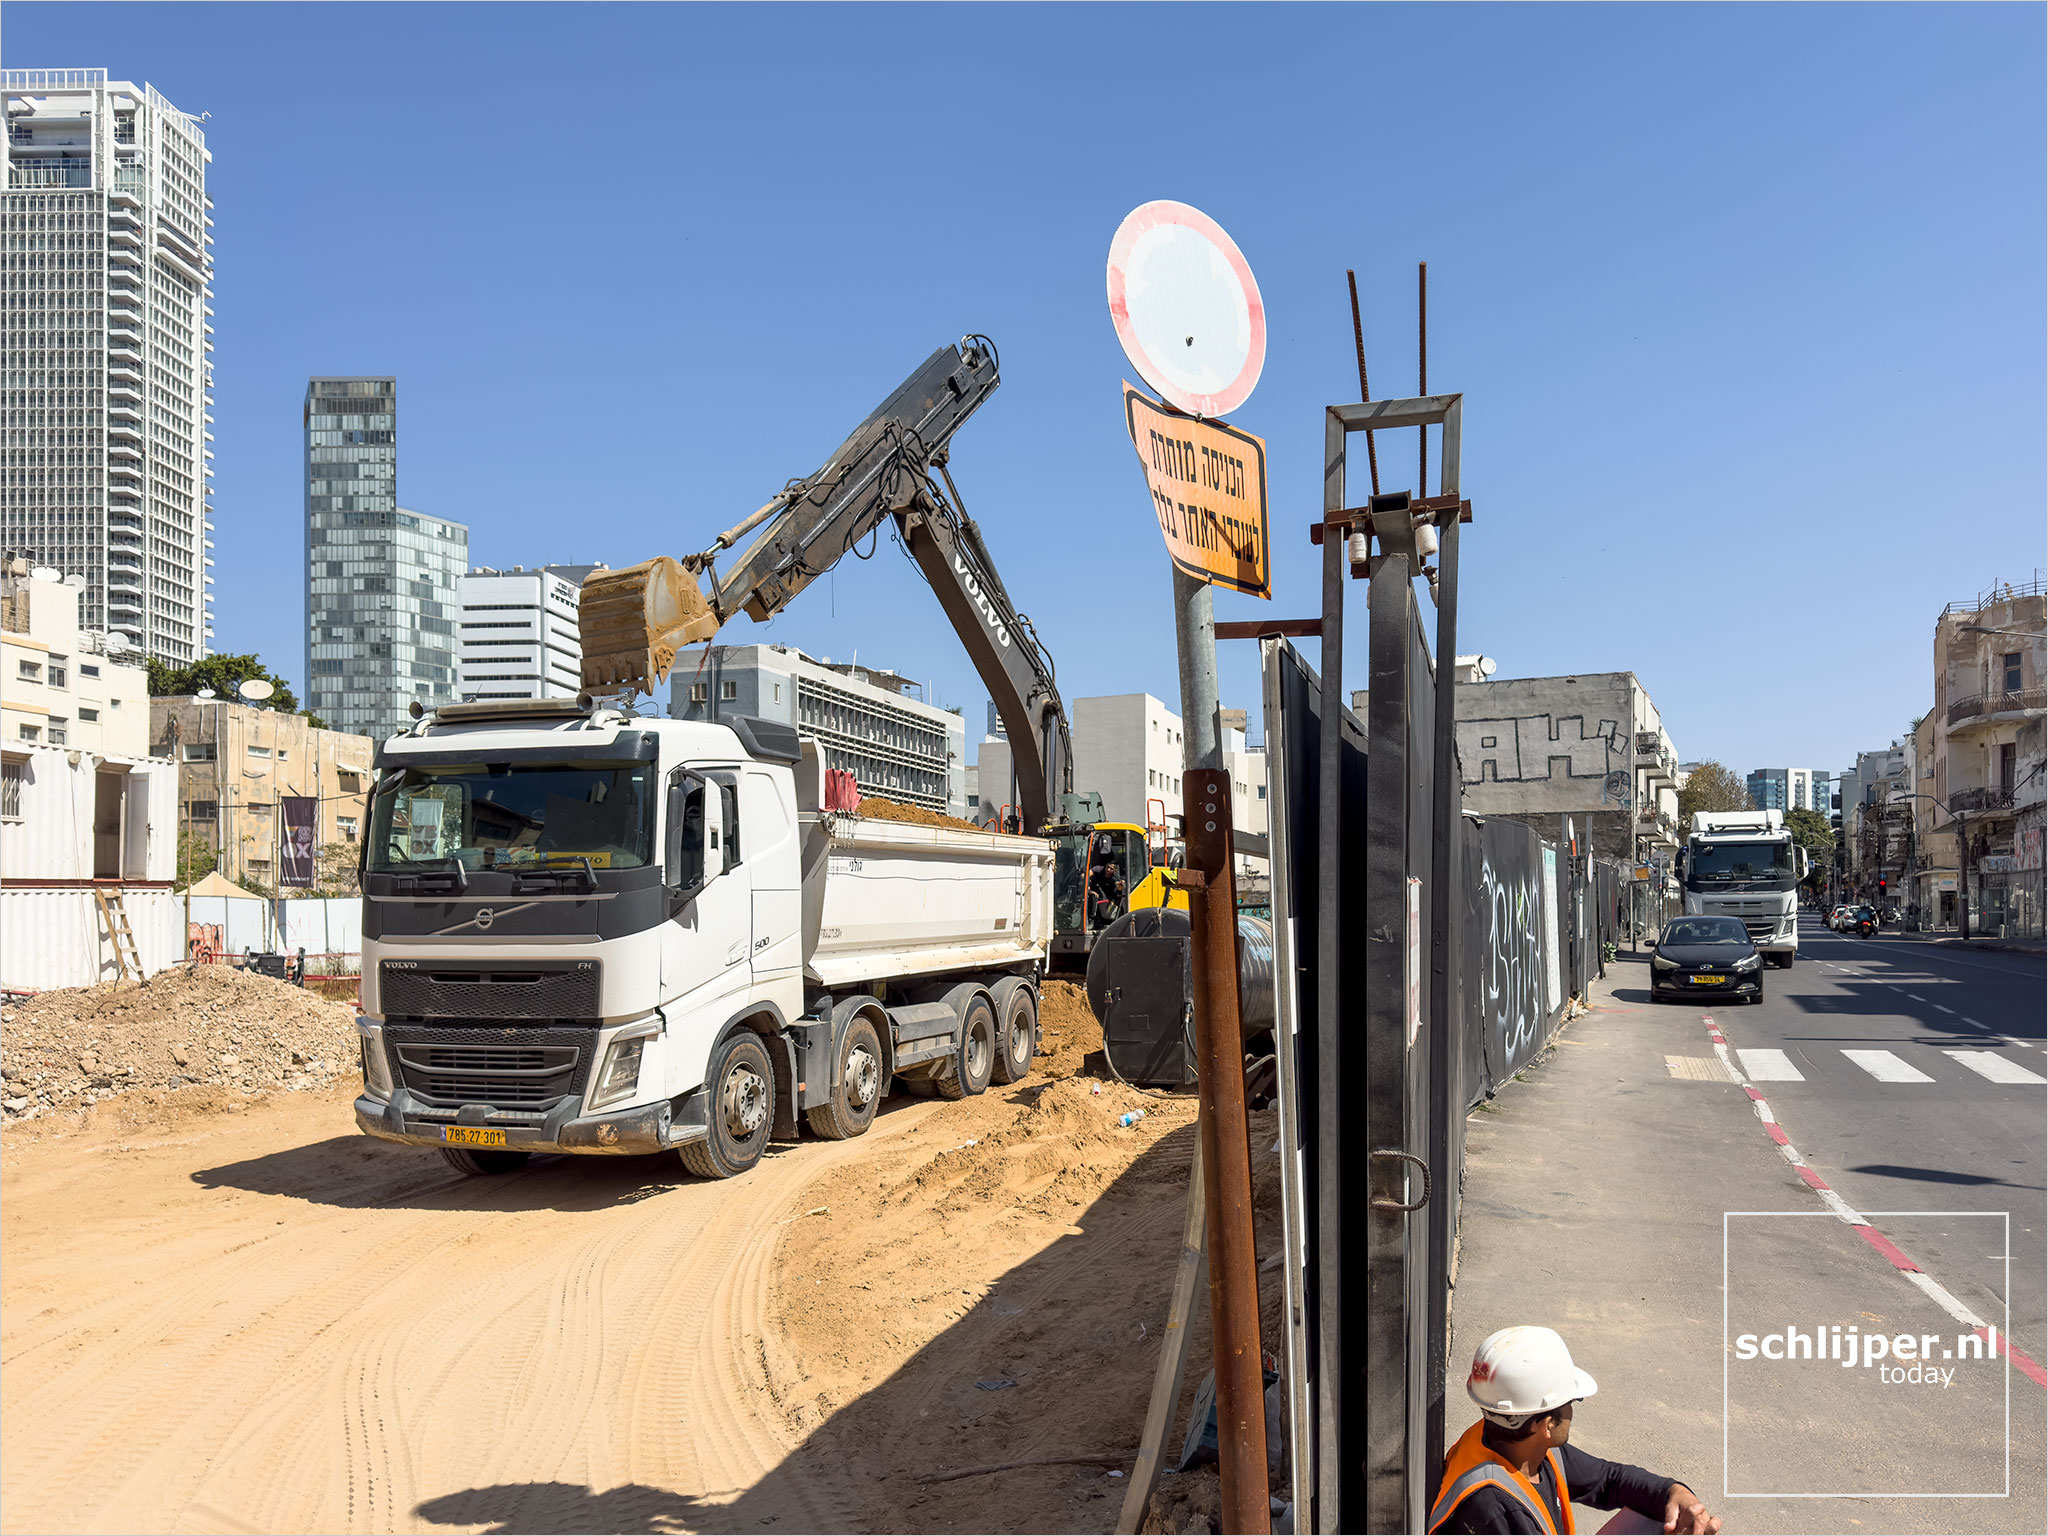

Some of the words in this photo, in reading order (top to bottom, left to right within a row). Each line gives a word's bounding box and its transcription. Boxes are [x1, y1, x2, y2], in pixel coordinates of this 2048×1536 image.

[1149, 428, 1197, 483] מותרת
[1201, 446, 1245, 500] הכניסה
[1177, 502, 1218, 552] האתר
[954, 553, 1011, 648] VOLVO
[384, 961, 418, 969] VOLVO
[577, 962, 593, 970] FH
[755, 936, 770, 951] 500
